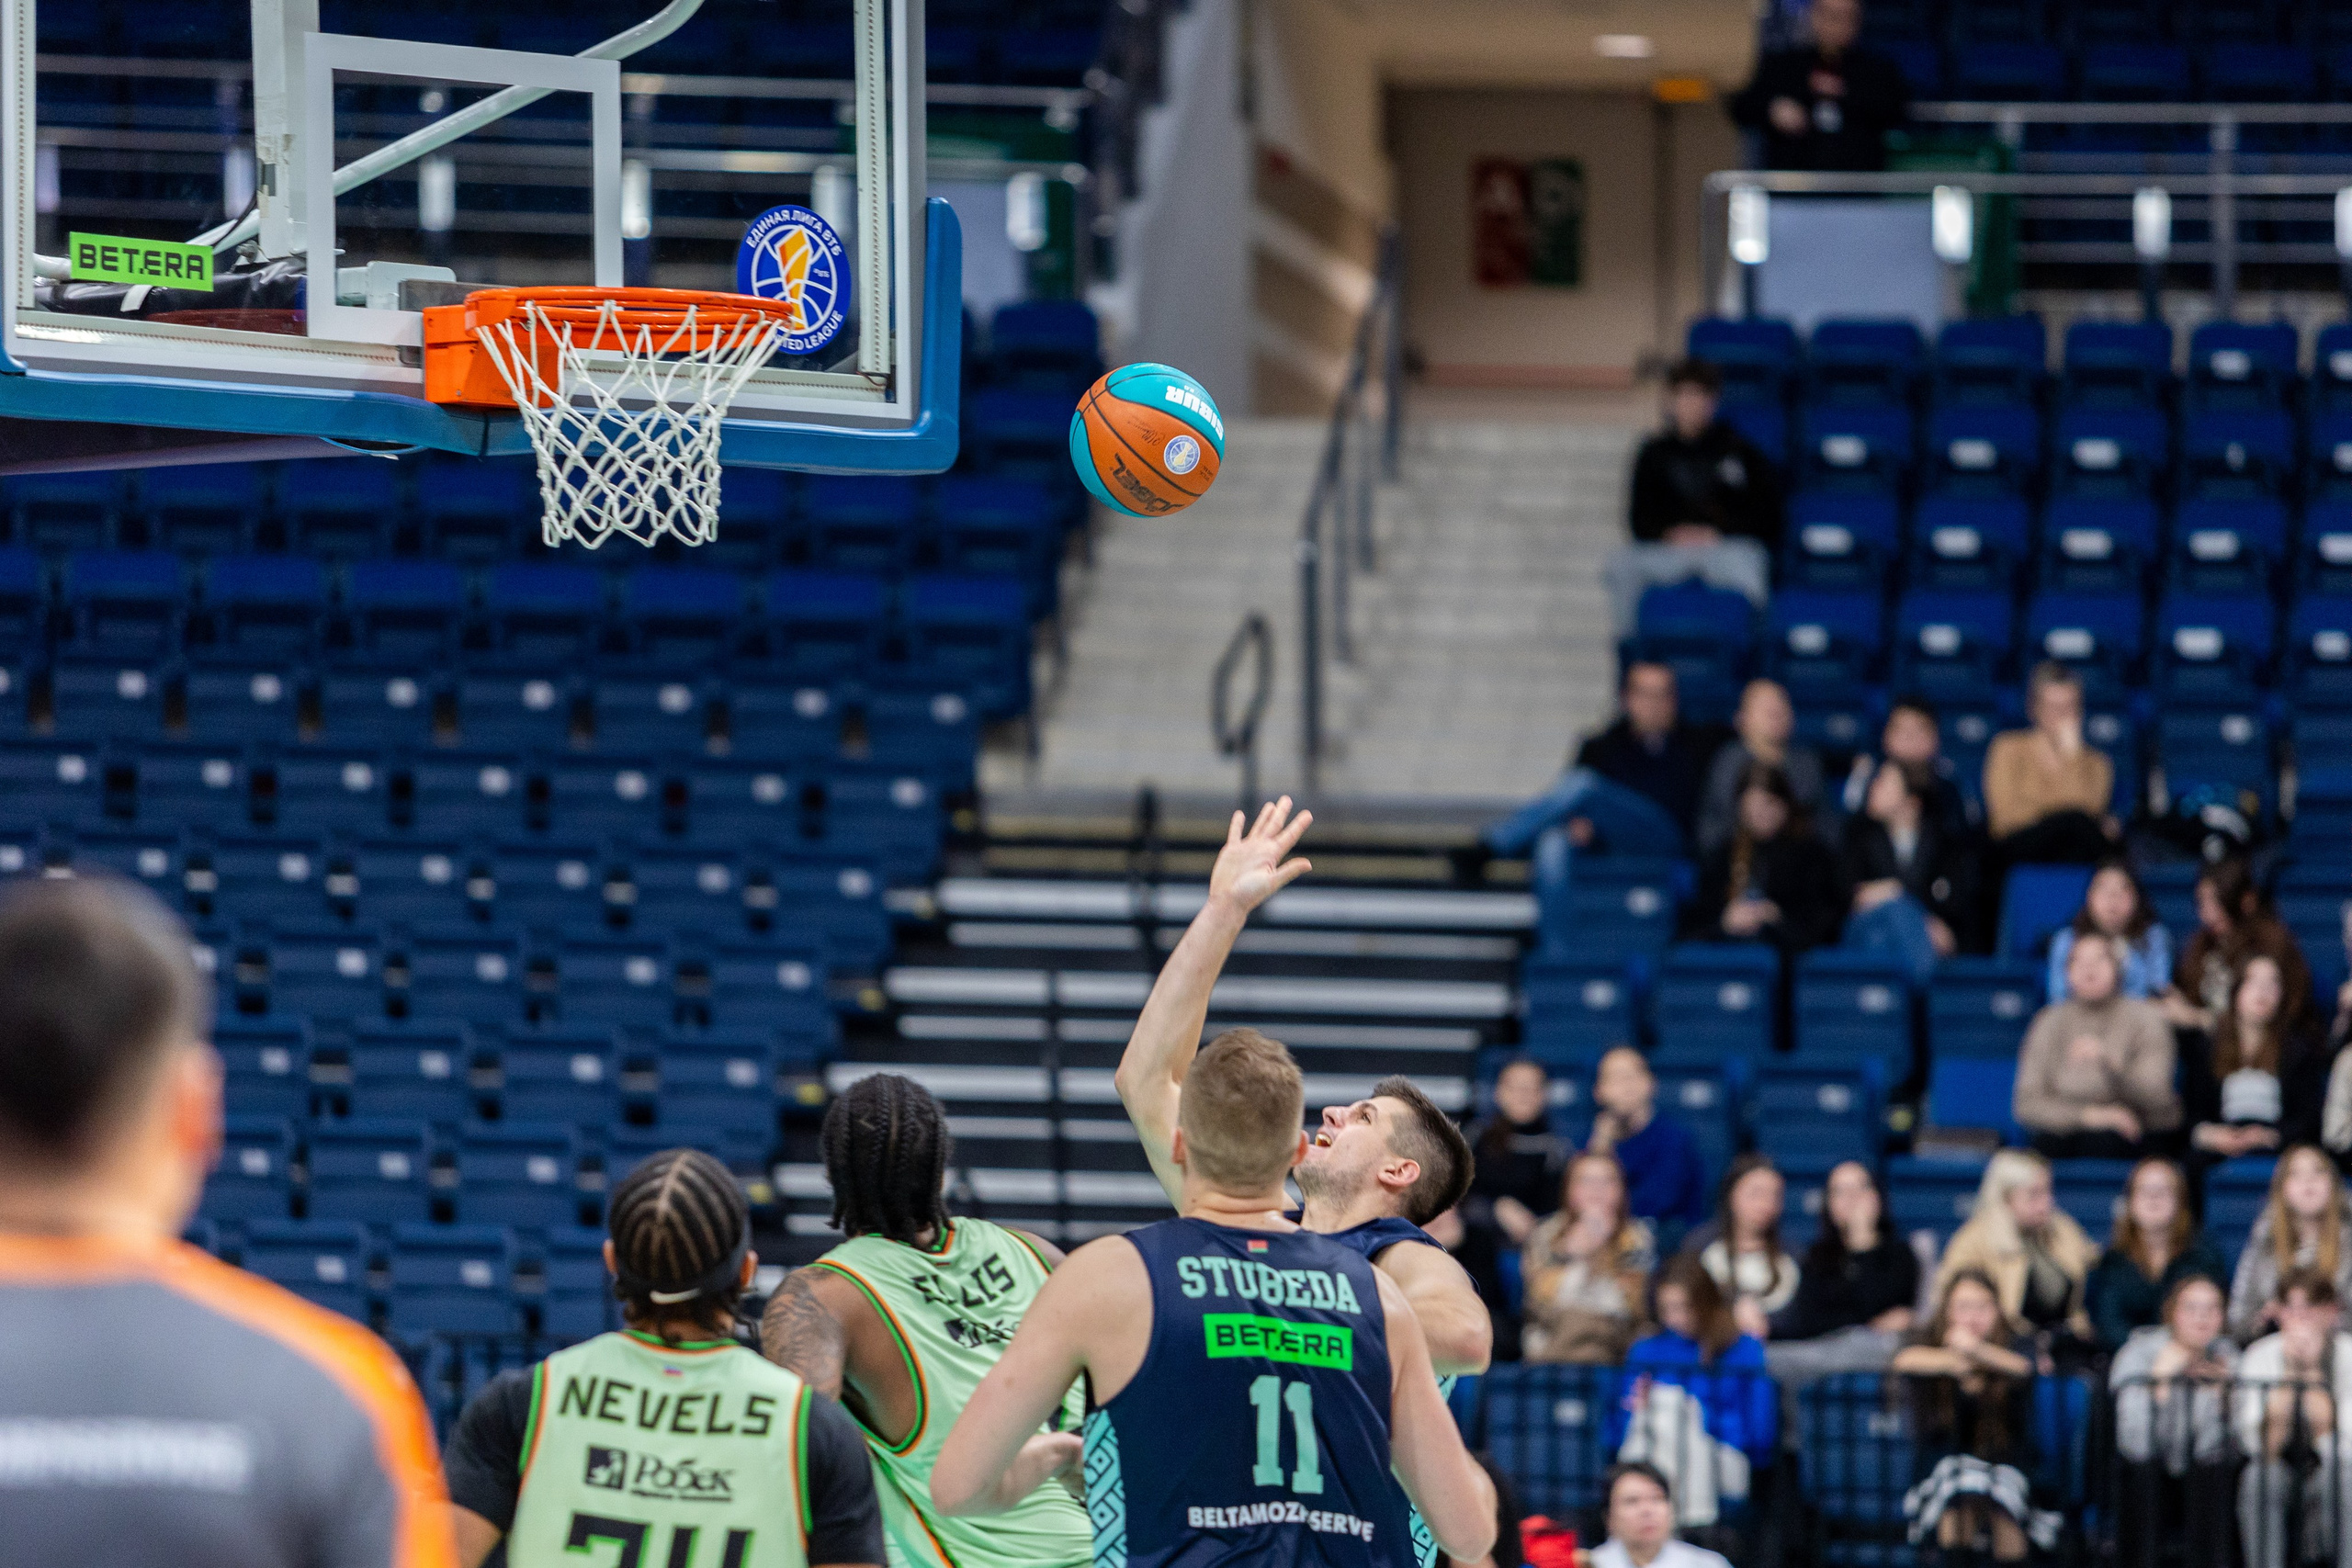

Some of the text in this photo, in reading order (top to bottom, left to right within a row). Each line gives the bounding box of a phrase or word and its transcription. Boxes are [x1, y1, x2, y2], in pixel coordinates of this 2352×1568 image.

[746, 209, 842, 256] ЕДИНАЯ ЛИГА ВТБ
[804, 310, 843, 349] LEAGUE
[1165, 385, 1225, 441] SIBUR
[1176, 1256, 1363, 1314] STUBEDA
[558, 1377, 777, 1437] NEVELS
[1249, 1374, 1325, 1495] 11
